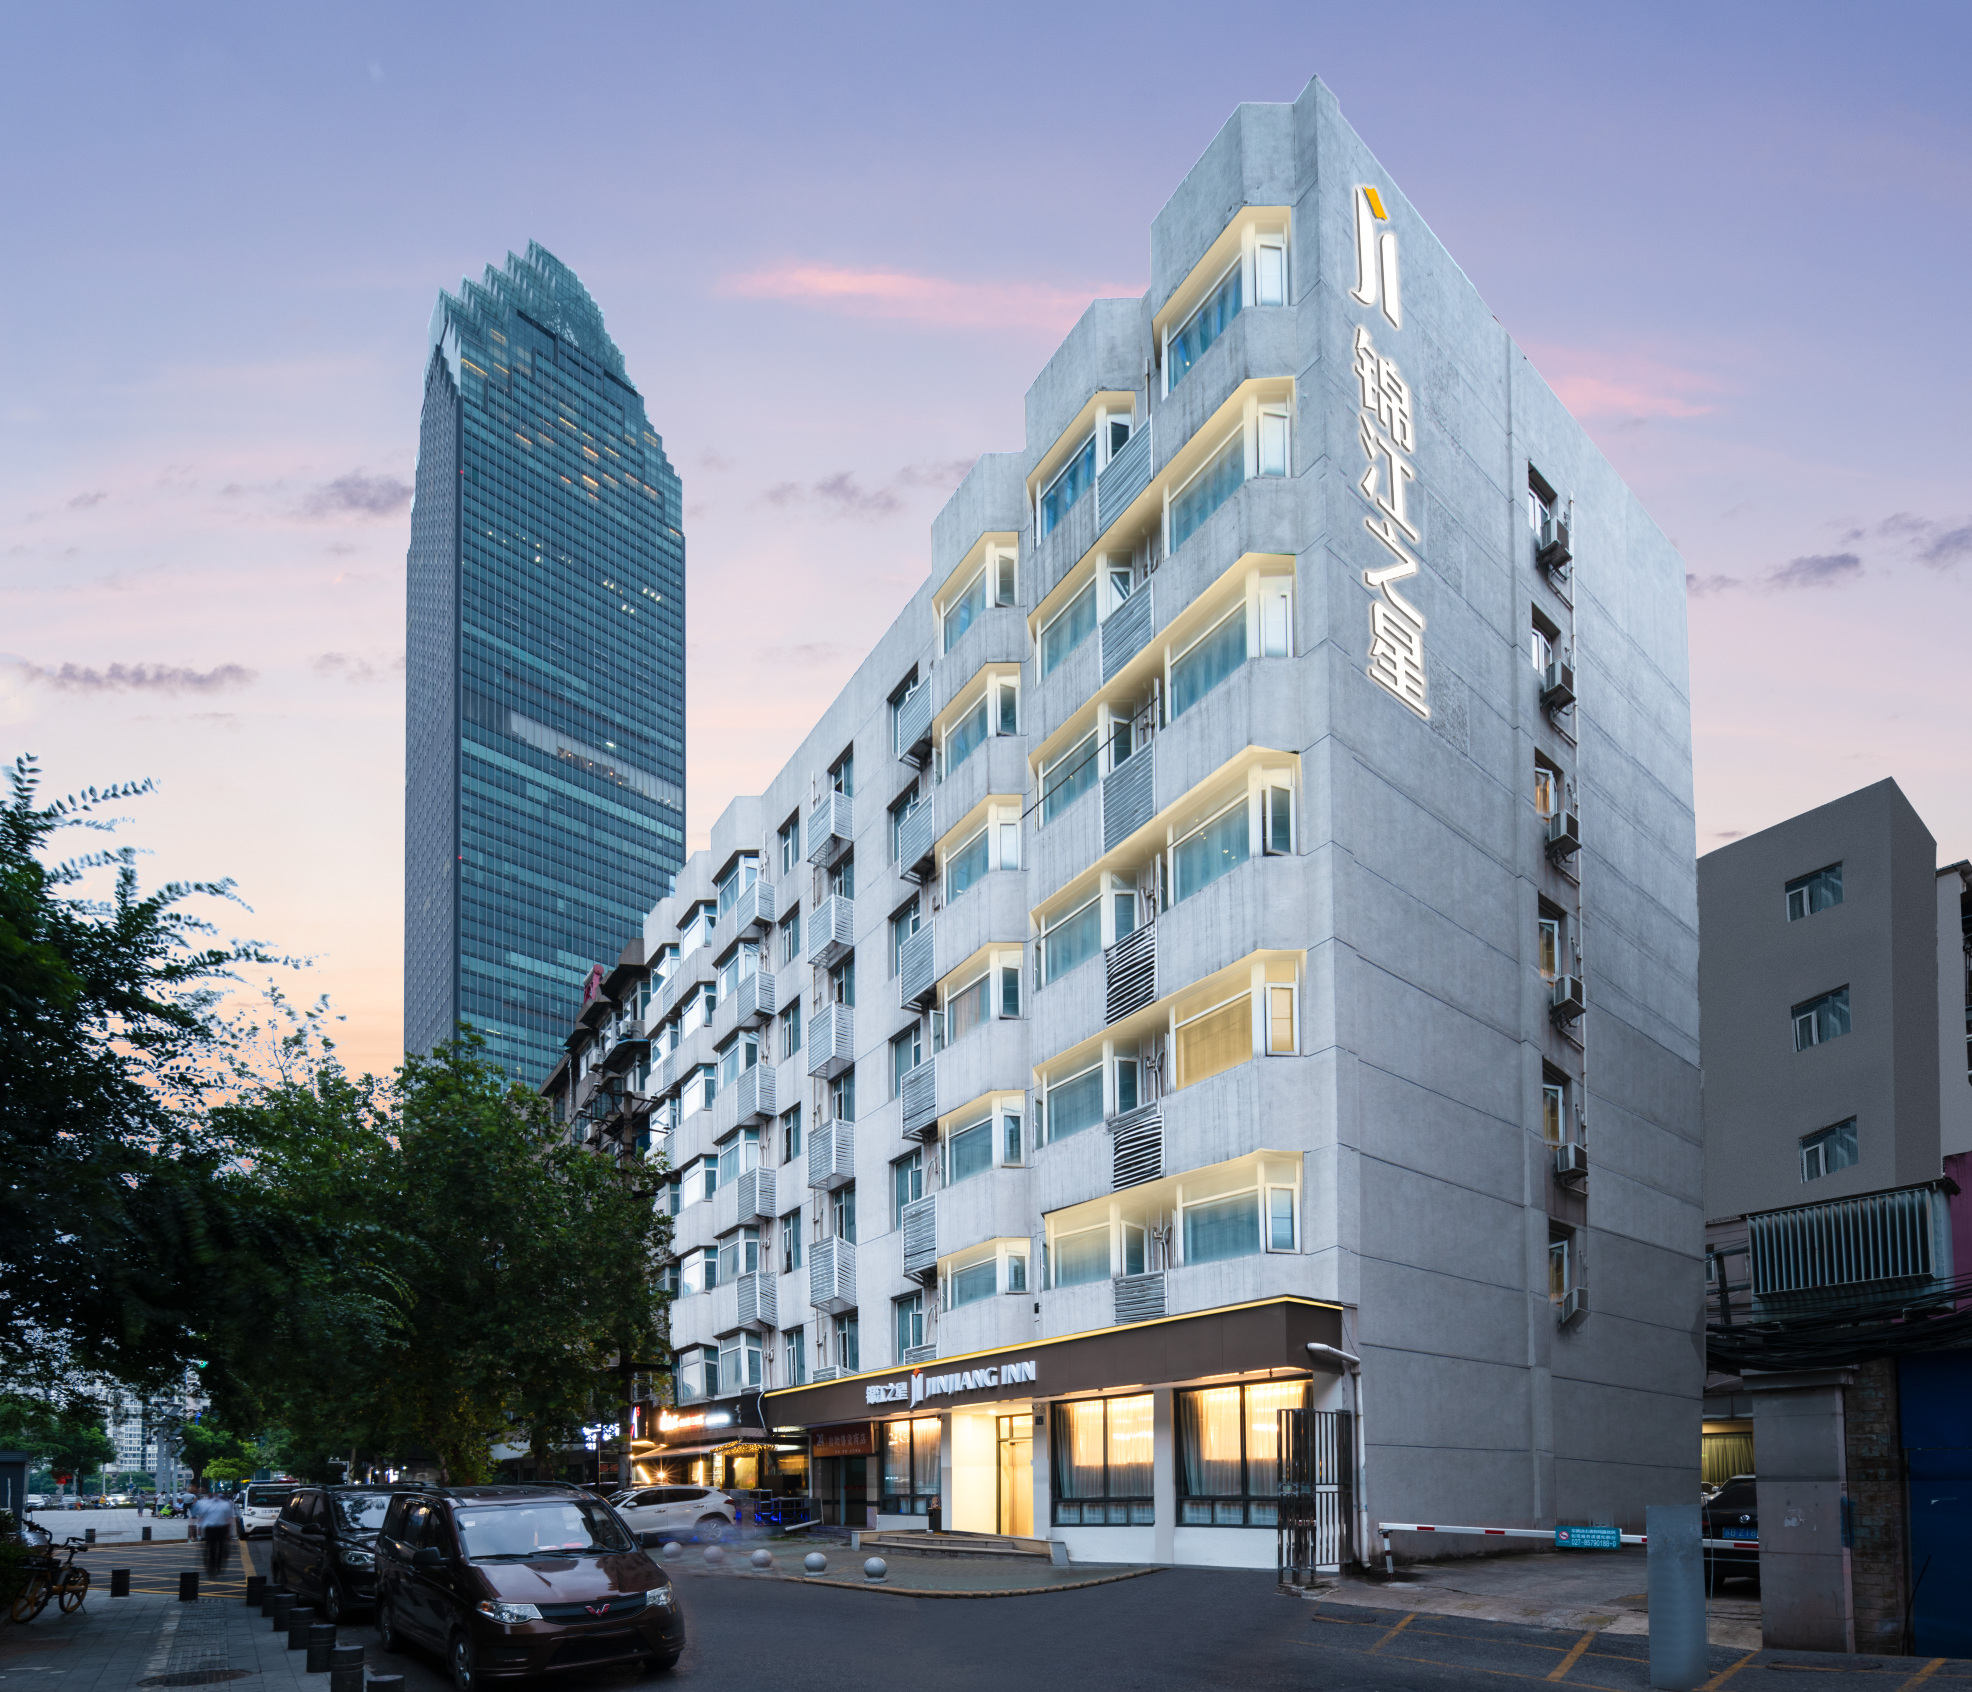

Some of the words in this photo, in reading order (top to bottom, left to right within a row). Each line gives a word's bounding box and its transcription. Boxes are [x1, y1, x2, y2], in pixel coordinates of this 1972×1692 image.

[1354, 327, 1429, 717] 锦江之星
[866, 1381, 909, 1404] 锦江之星
[926, 1366, 999, 1398] JINJIANG
[1001, 1360, 1036, 1385] INN
